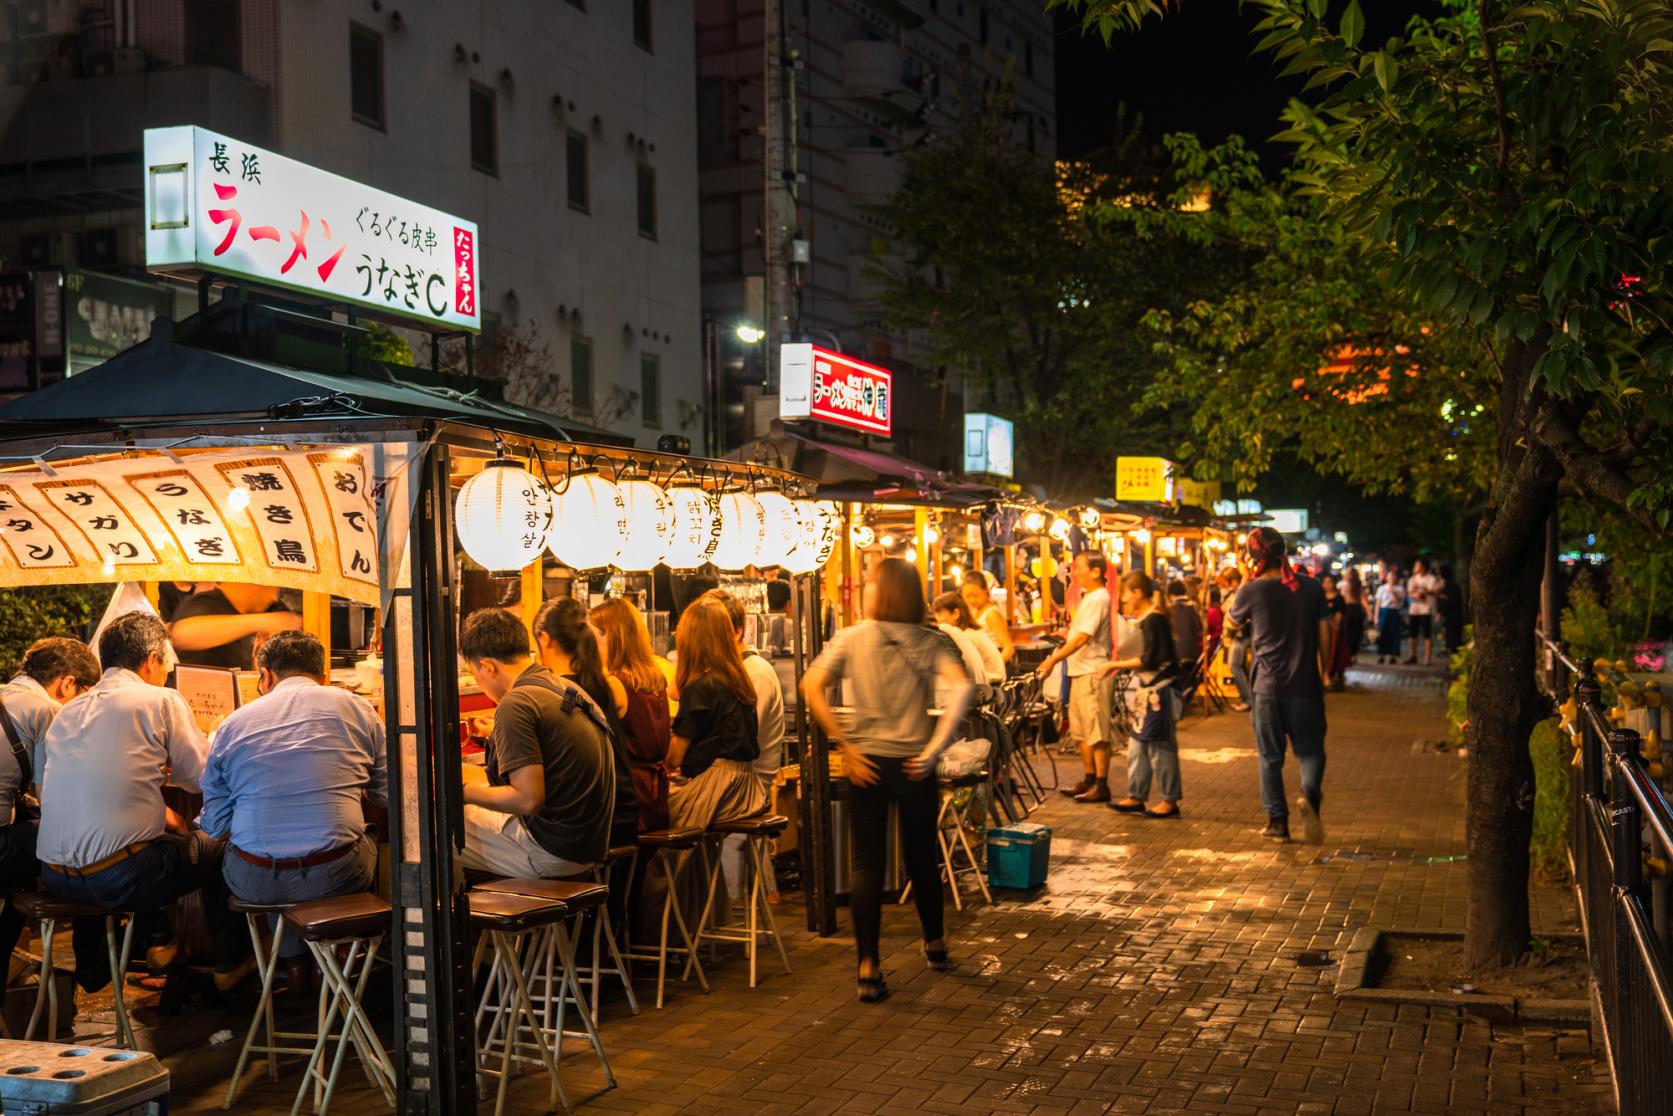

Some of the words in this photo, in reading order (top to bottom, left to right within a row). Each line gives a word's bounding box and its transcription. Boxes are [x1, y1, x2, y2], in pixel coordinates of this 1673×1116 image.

[208, 141, 262, 186] 長浜
[207, 181, 348, 284] ラーメン
[355, 206, 438, 256] ぐるぐる皮串
[455, 231, 474, 315] たっちゃん
[155, 482, 225, 557] うなぎ
[241, 472, 307, 564] 焼き鳥
[333, 470, 371, 574] おでん
[521, 488, 540, 549] 안창살
[697, 495, 723, 561] 焼き鳥
